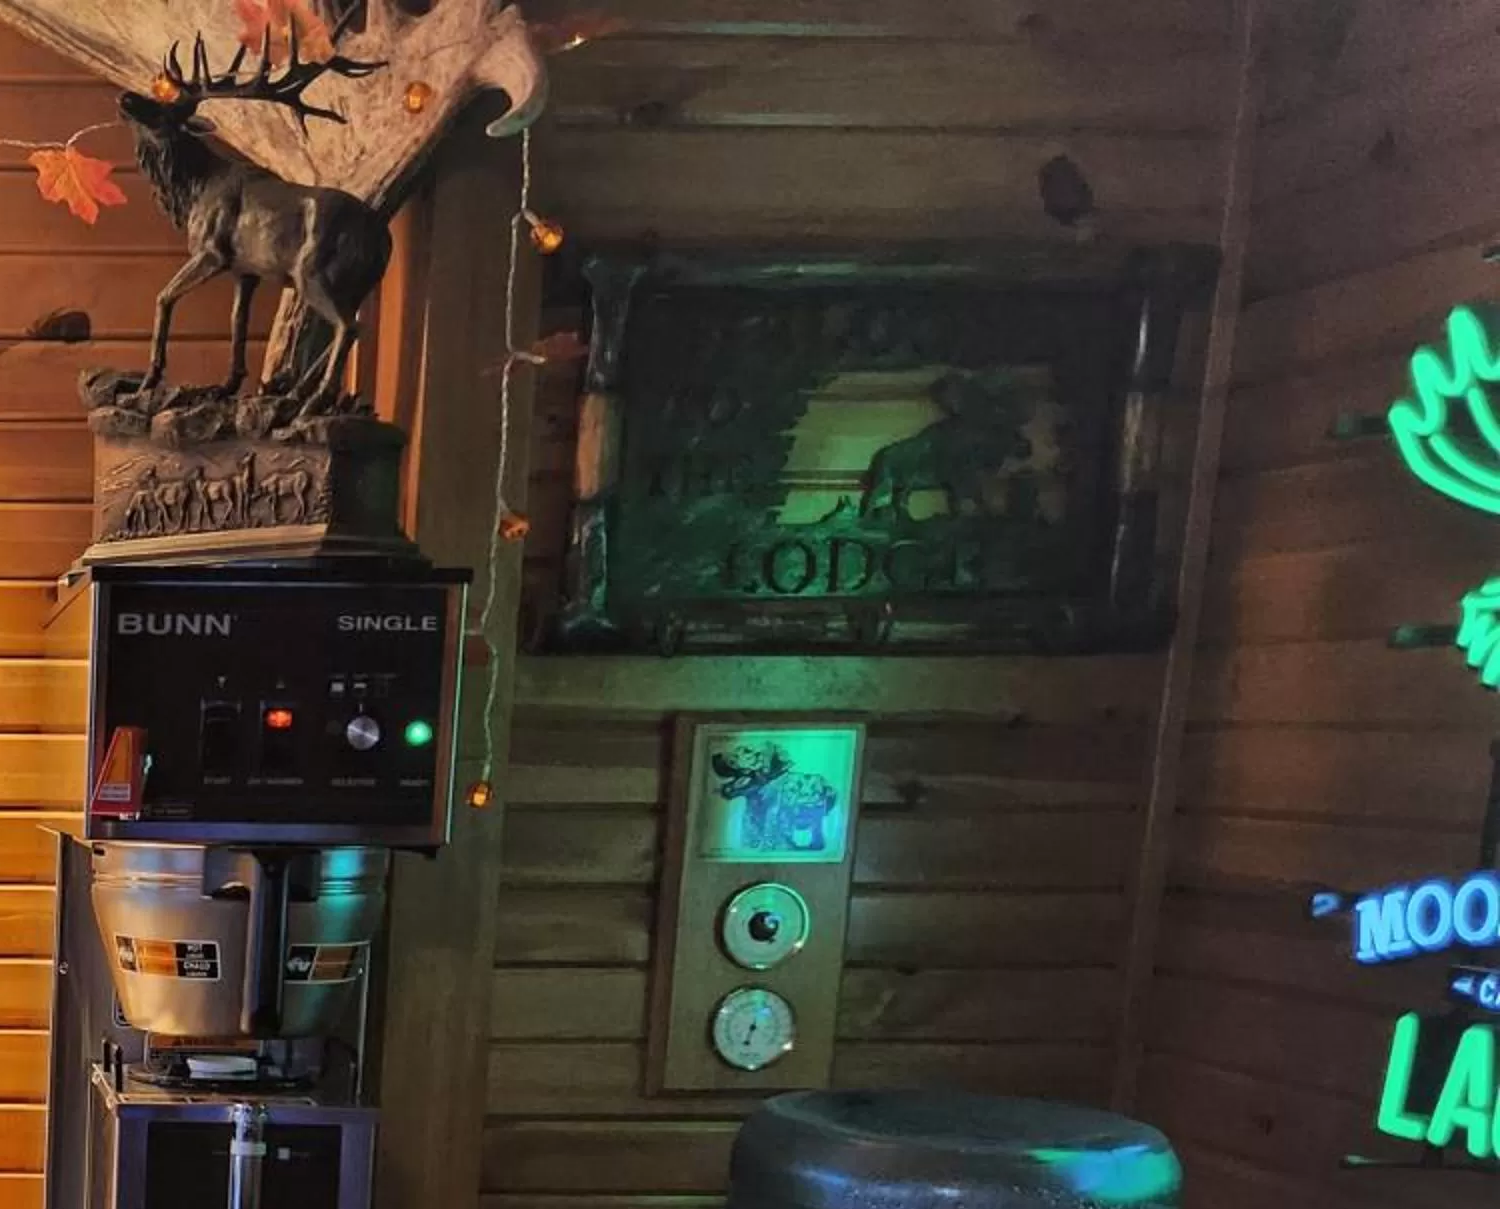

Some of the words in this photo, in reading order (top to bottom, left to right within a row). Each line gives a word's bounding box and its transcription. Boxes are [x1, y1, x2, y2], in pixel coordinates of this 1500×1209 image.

[116, 612, 233, 636] BUNN
[337, 614, 438, 632] SINGLE
[1355, 876, 1500, 962] MOO
[1377, 1011, 1500, 1159] LA
